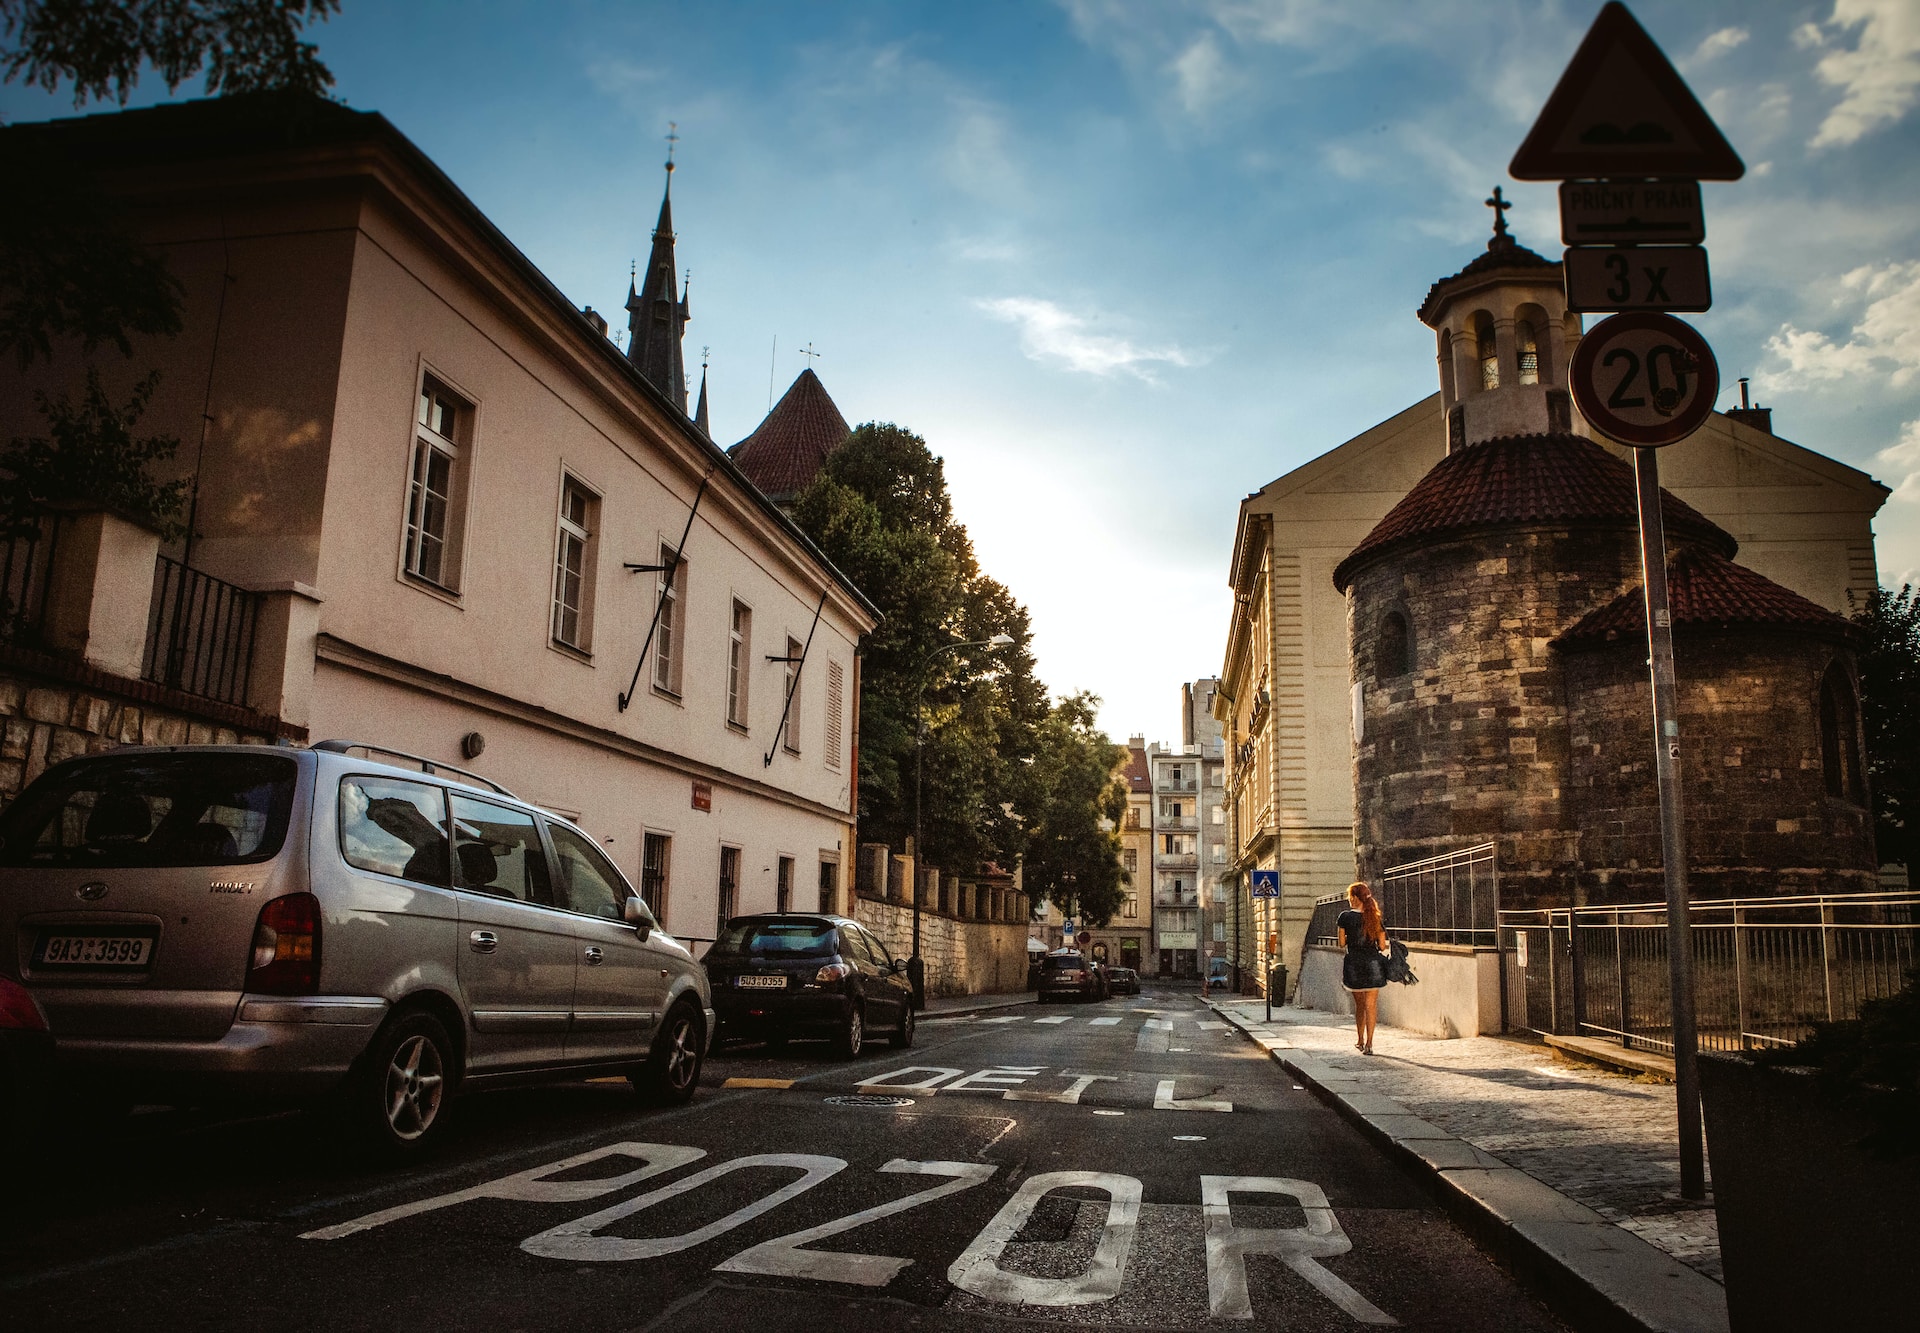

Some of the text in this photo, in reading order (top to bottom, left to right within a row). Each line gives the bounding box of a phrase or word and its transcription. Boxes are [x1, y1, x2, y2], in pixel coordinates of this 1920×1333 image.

[1570, 185, 1693, 210] PŘÍČNÝ PRÁH
[1604, 253, 1630, 303] 3
[1602, 344, 1688, 418] 20
[209, 881, 255, 894] TRAJET
[48, 940, 143, 962] 9A3 3599
[297, 1141, 1400, 1327] POZOR
